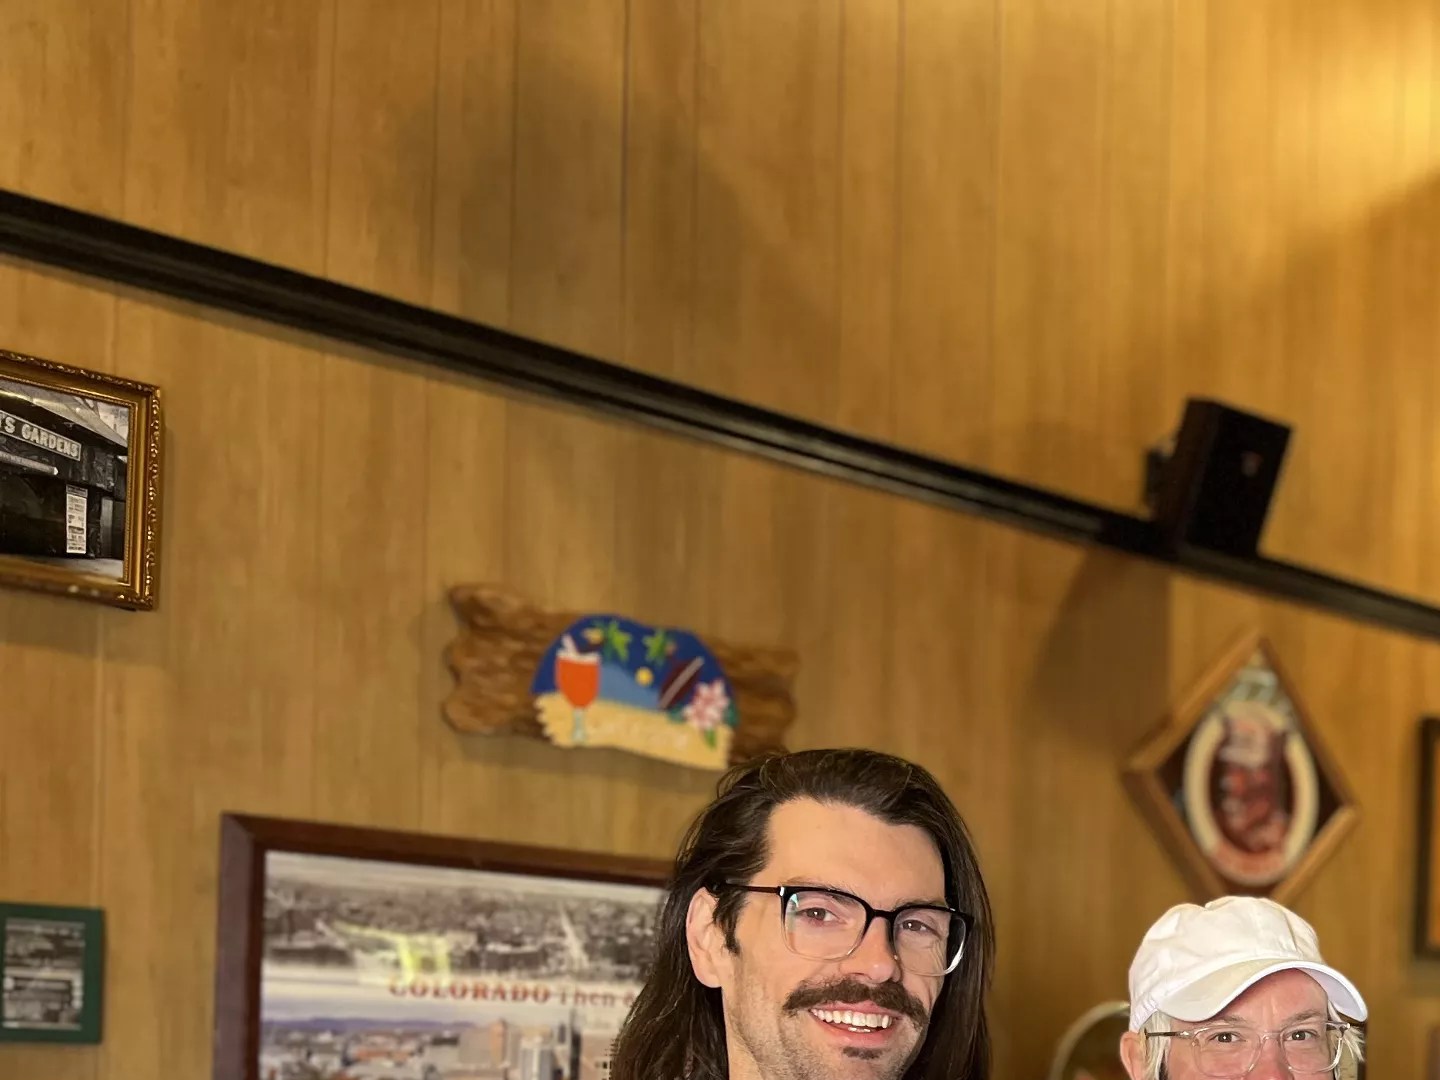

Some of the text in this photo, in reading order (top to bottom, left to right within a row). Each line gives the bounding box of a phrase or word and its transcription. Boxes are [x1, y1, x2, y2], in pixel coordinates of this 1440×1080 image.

[0, 412, 79, 457] 'S GARDENS
[388, 979, 551, 1005] COLORADO
